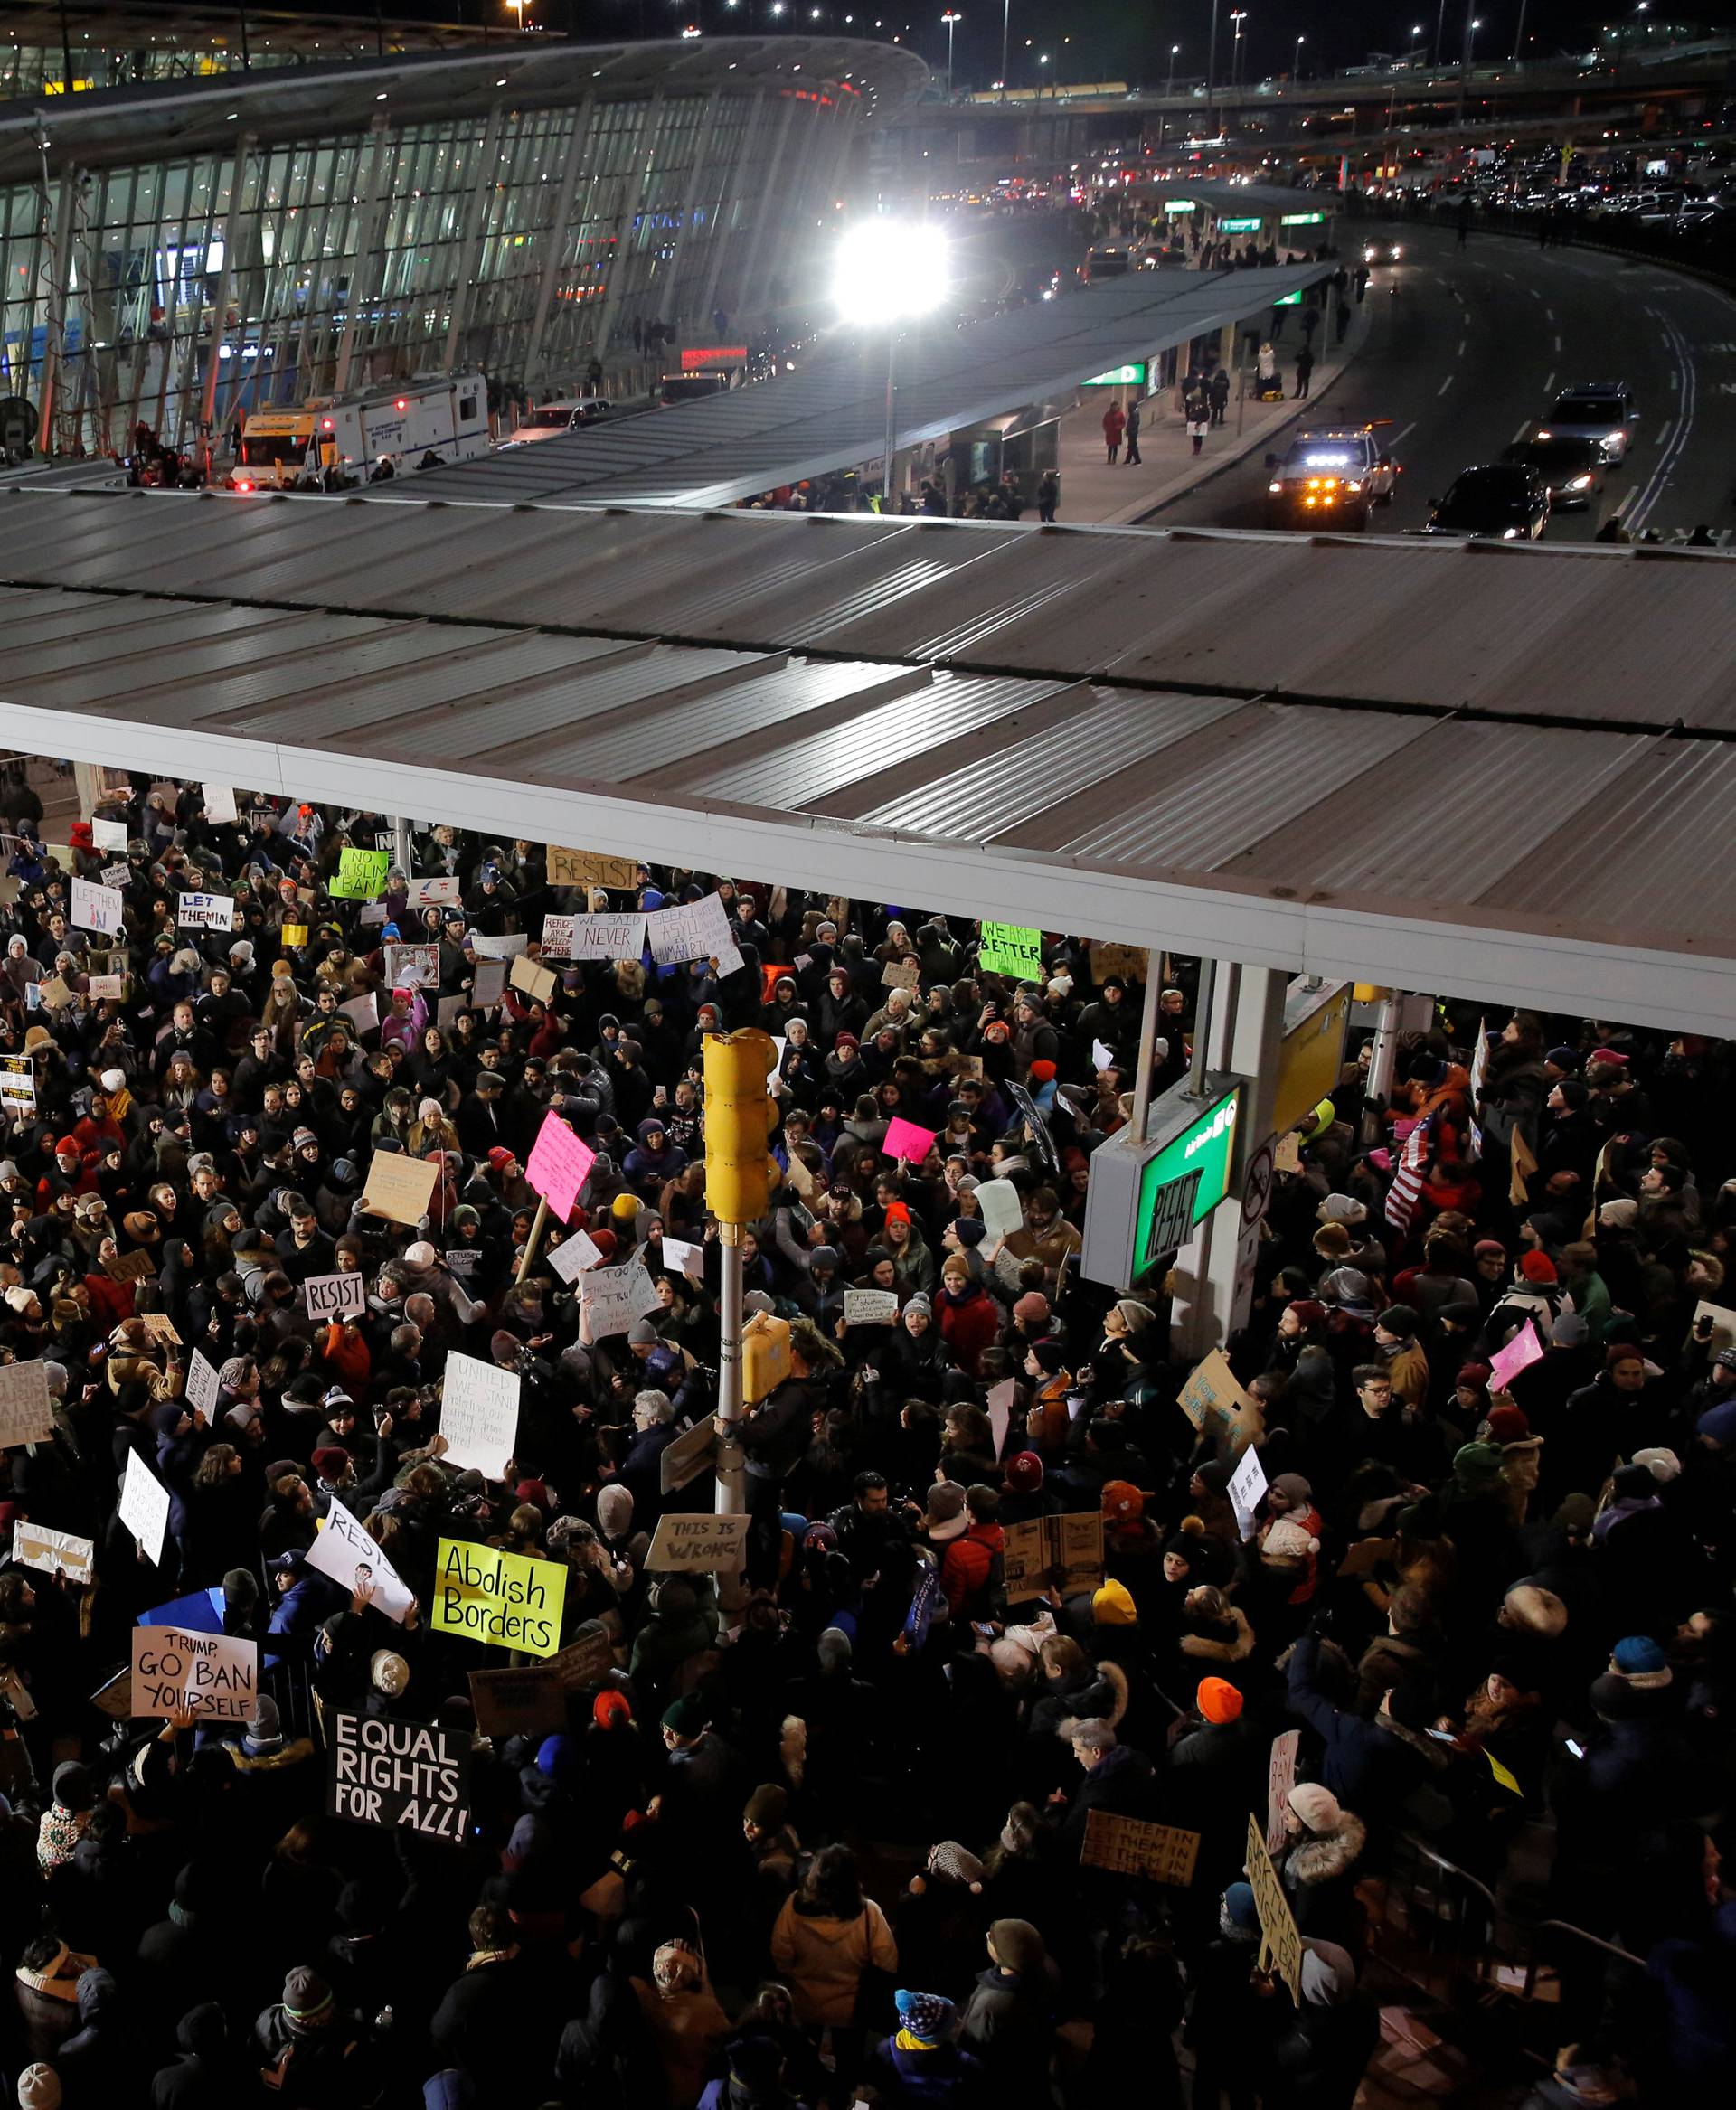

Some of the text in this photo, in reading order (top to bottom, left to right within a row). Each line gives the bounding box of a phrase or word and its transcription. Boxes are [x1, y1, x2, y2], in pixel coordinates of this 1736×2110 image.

[352, 852, 372, 862] NO
[340, 863, 387, 879] MUSLIM
[555, 856, 637, 888] RESIST
[76, 886, 120, 911] LET THEM
[342, 878, 376, 894] BAN
[183, 896, 214, 907] LET
[551, 929, 565, 937] ARE
[579, 915, 640, 926] WE SAID
[985, 921, 1031, 943] WE ARE
[585, 928, 630, 945] NEVER
[981, 936, 1041, 961] BETTER
[550, 947, 571, 956] HERE
[1146, 1168, 1203, 1262] RESIST
[310, 1277, 361, 1311] RESIST
[191, 1355, 202, 1384] BAN
[199, 1367, 211, 1394] WALL
[458, 1360, 510, 1389] UNITED
[456, 1380, 516, 1410] WE STAND
[1245, 1474, 1253, 1490] ARE
[1251, 1465, 1259, 1479] WE
[671, 1522, 736, 1536] THIS IS
[445, 1545, 545, 1609] Abolish
[444, 1587, 552, 1648] Borders
[165, 1634, 218, 1658] TRUMP,
[139, 1652, 251, 1691] GO BAN
[143, 1682, 250, 1717] YOURSELF
[337, 1714, 458, 1766] EQUAL
[336, 1747, 459, 1803] RIGHTS
[1271, 1757, 1291, 1790] BAN
[335, 1783, 467, 1842] FOR ALL!
[1123, 1820, 1169, 1839] THEM
[1175, 1832, 1194, 1845] IN
[1120, 1834, 1165, 1853] THEM
[1171, 1846, 1189, 1860] IN
[1117, 1848, 1160, 1868] THEM
[1168, 1860, 1186, 1872] IN
